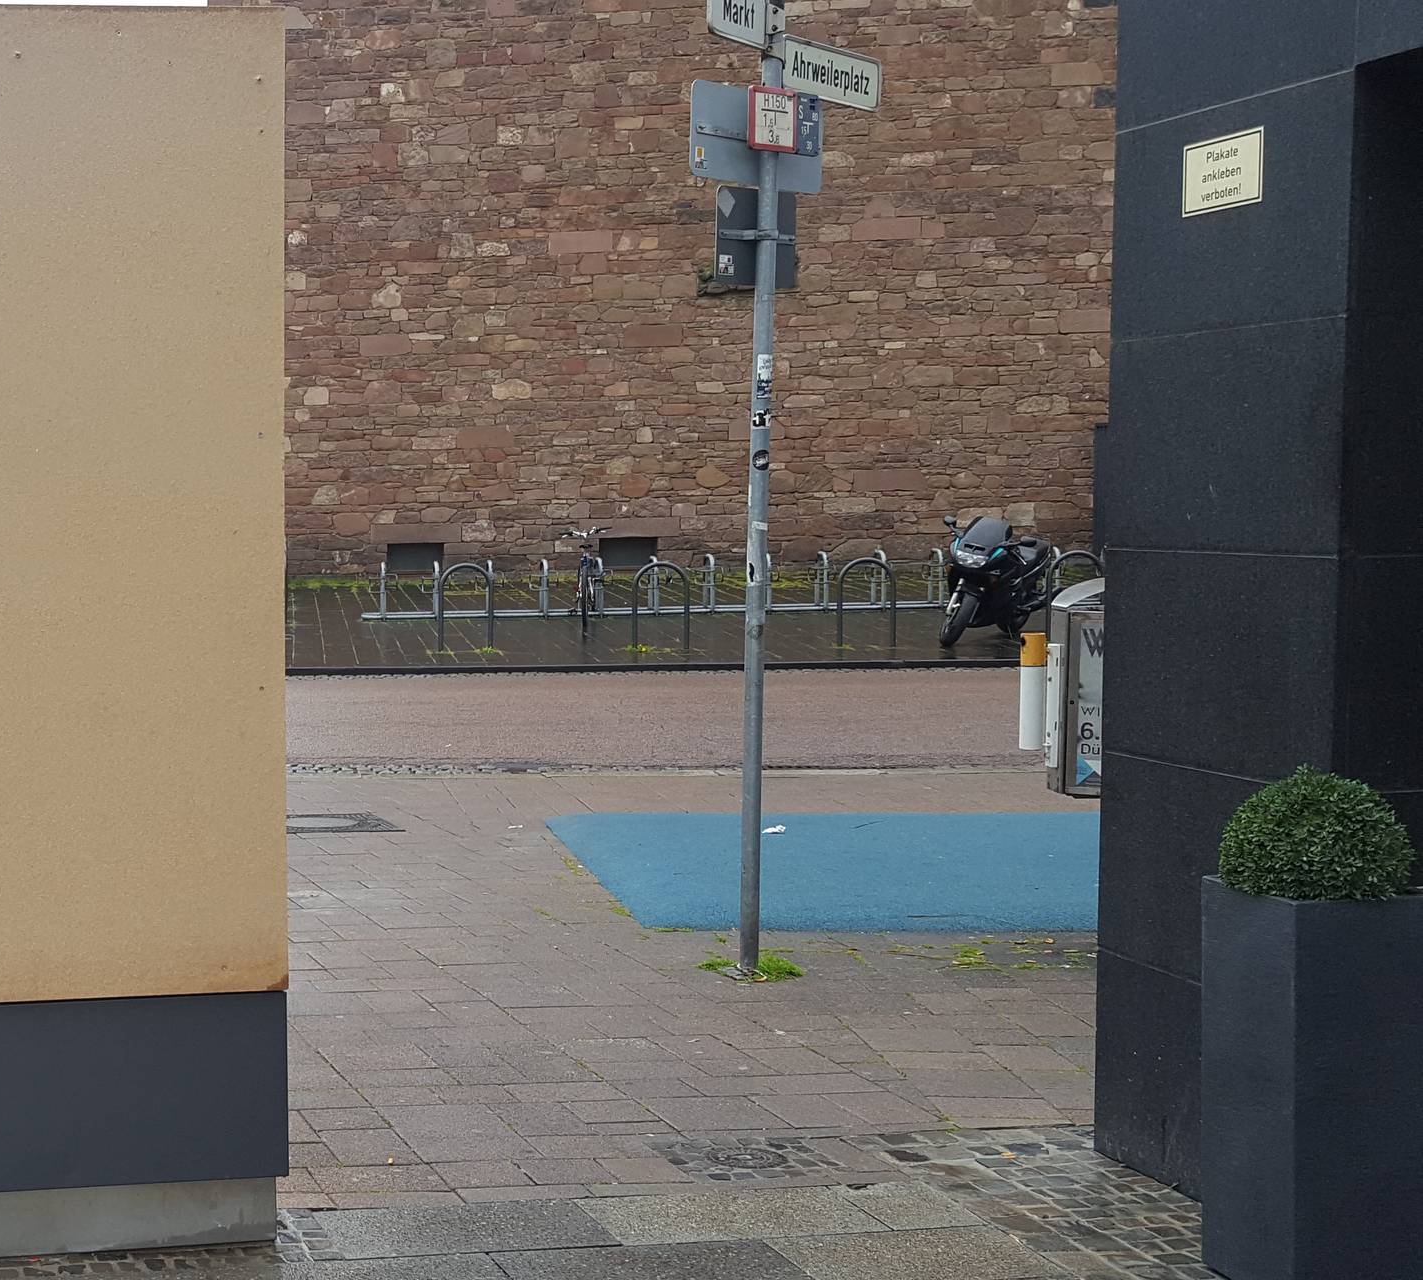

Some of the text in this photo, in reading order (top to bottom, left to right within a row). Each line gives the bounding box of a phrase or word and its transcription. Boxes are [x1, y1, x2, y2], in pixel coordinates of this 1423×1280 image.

[723, 0, 755, 29] Markt
[792, 51, 870, 97] Ahrweilerplatz
[763, 94, 786, 110] H150
[1206, 146, 1239, 163] Plakate
[1201, 166, 1242, 183] ankleben
[1200, 182, 1242, 202] verboten!
[1081, 722, 1100, 741] 6.
[1081, 743, 1100, 755] Dü
